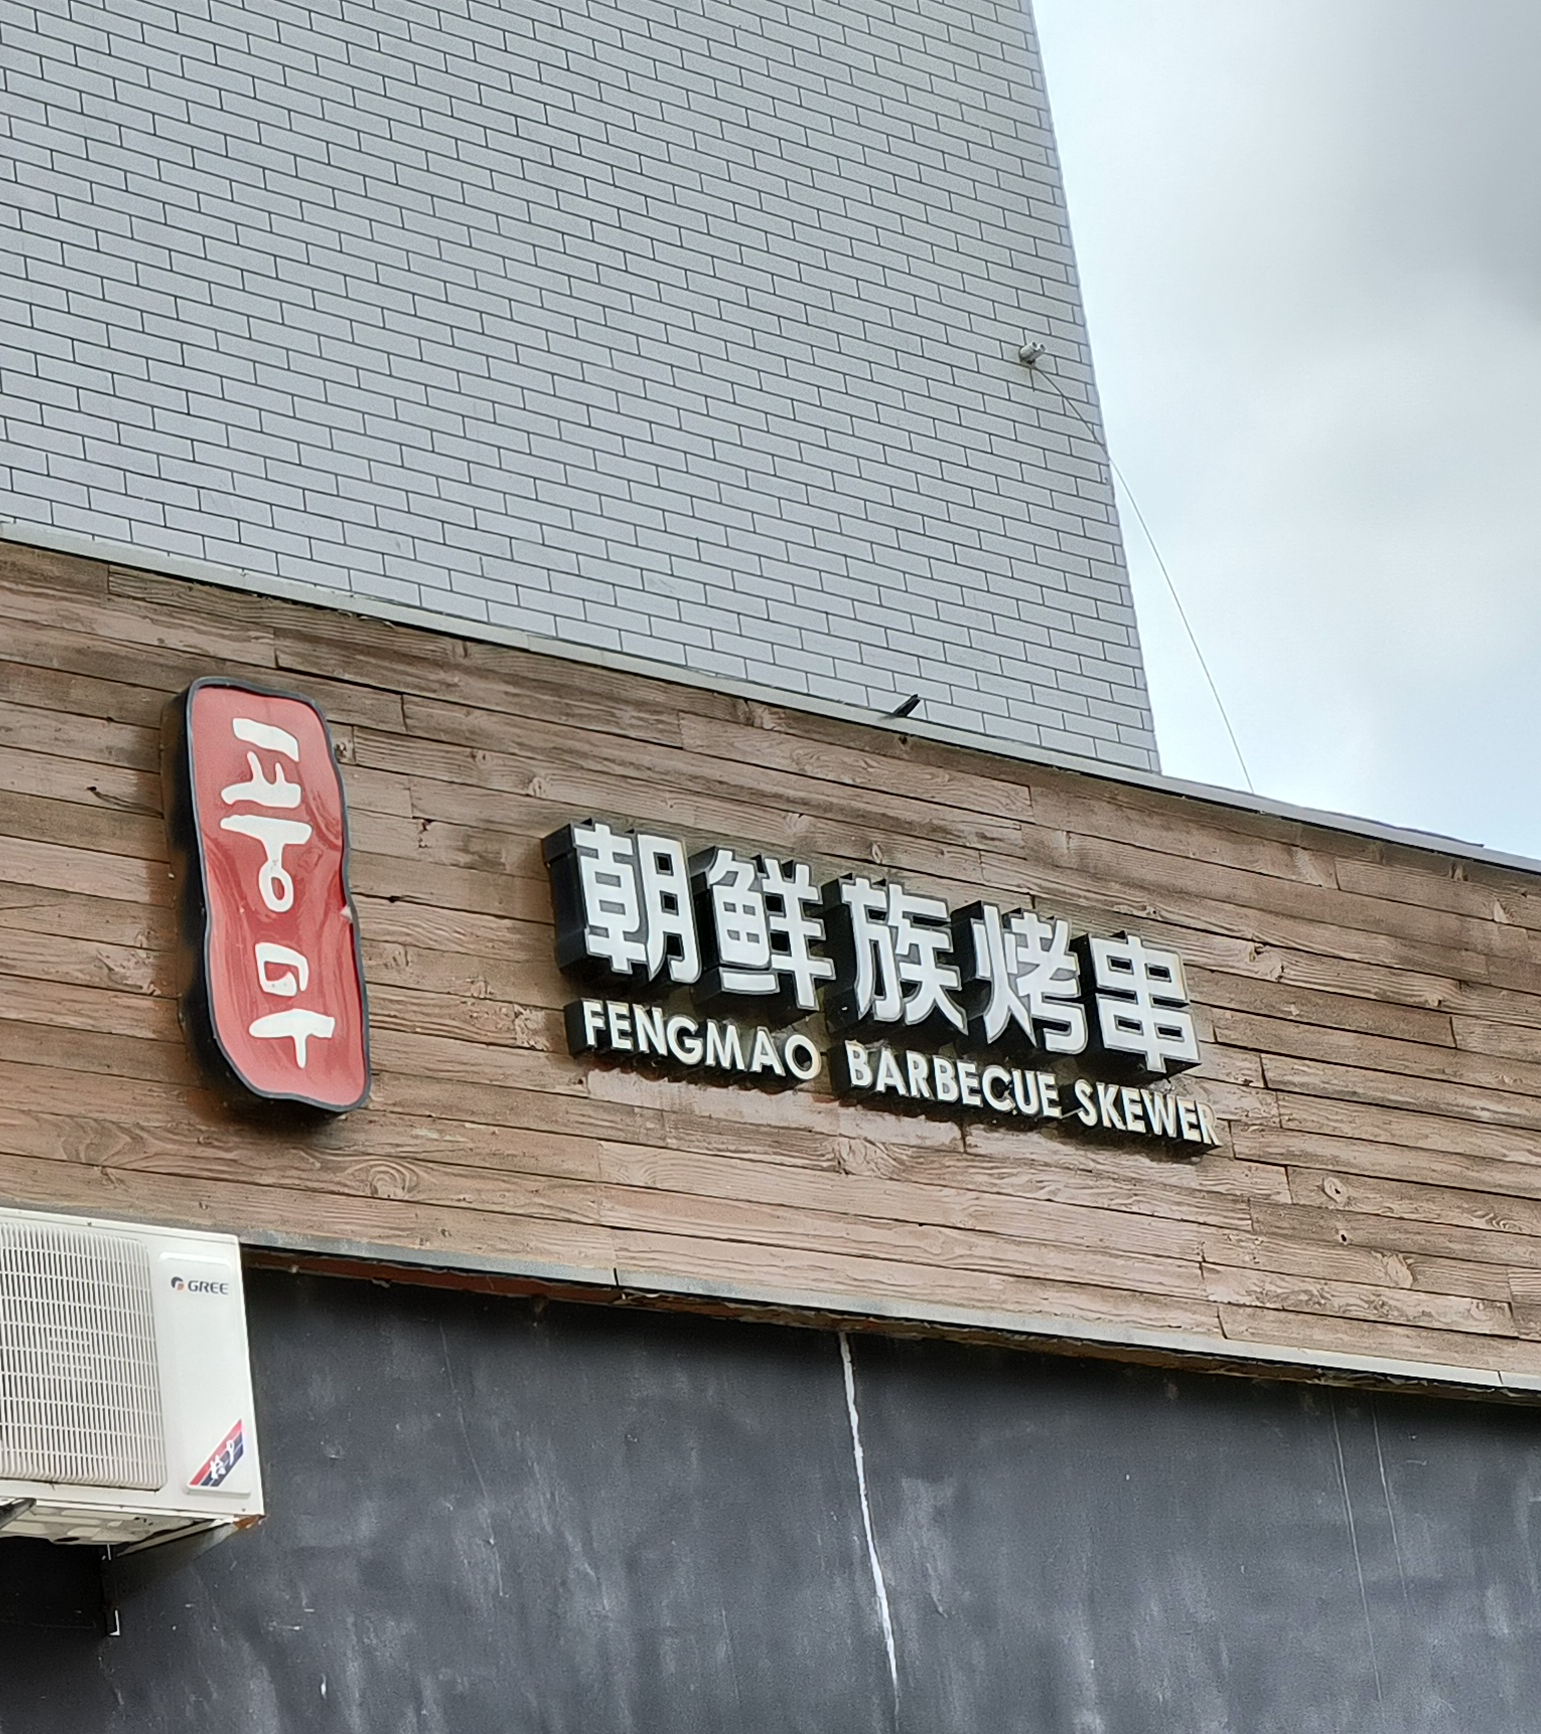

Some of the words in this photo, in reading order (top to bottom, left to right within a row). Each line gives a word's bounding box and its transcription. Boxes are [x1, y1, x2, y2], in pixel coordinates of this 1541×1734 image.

[571, 820, 1203, 1075] 朝鲜族烤串
[581, 998, 821, 1080] FENGMAO
[844, 1040, 1063, 1119] BARBECUE
[1074, 1079, 1223, 1147] SKEWER
[187, 1279, 229, 1295] GREE
